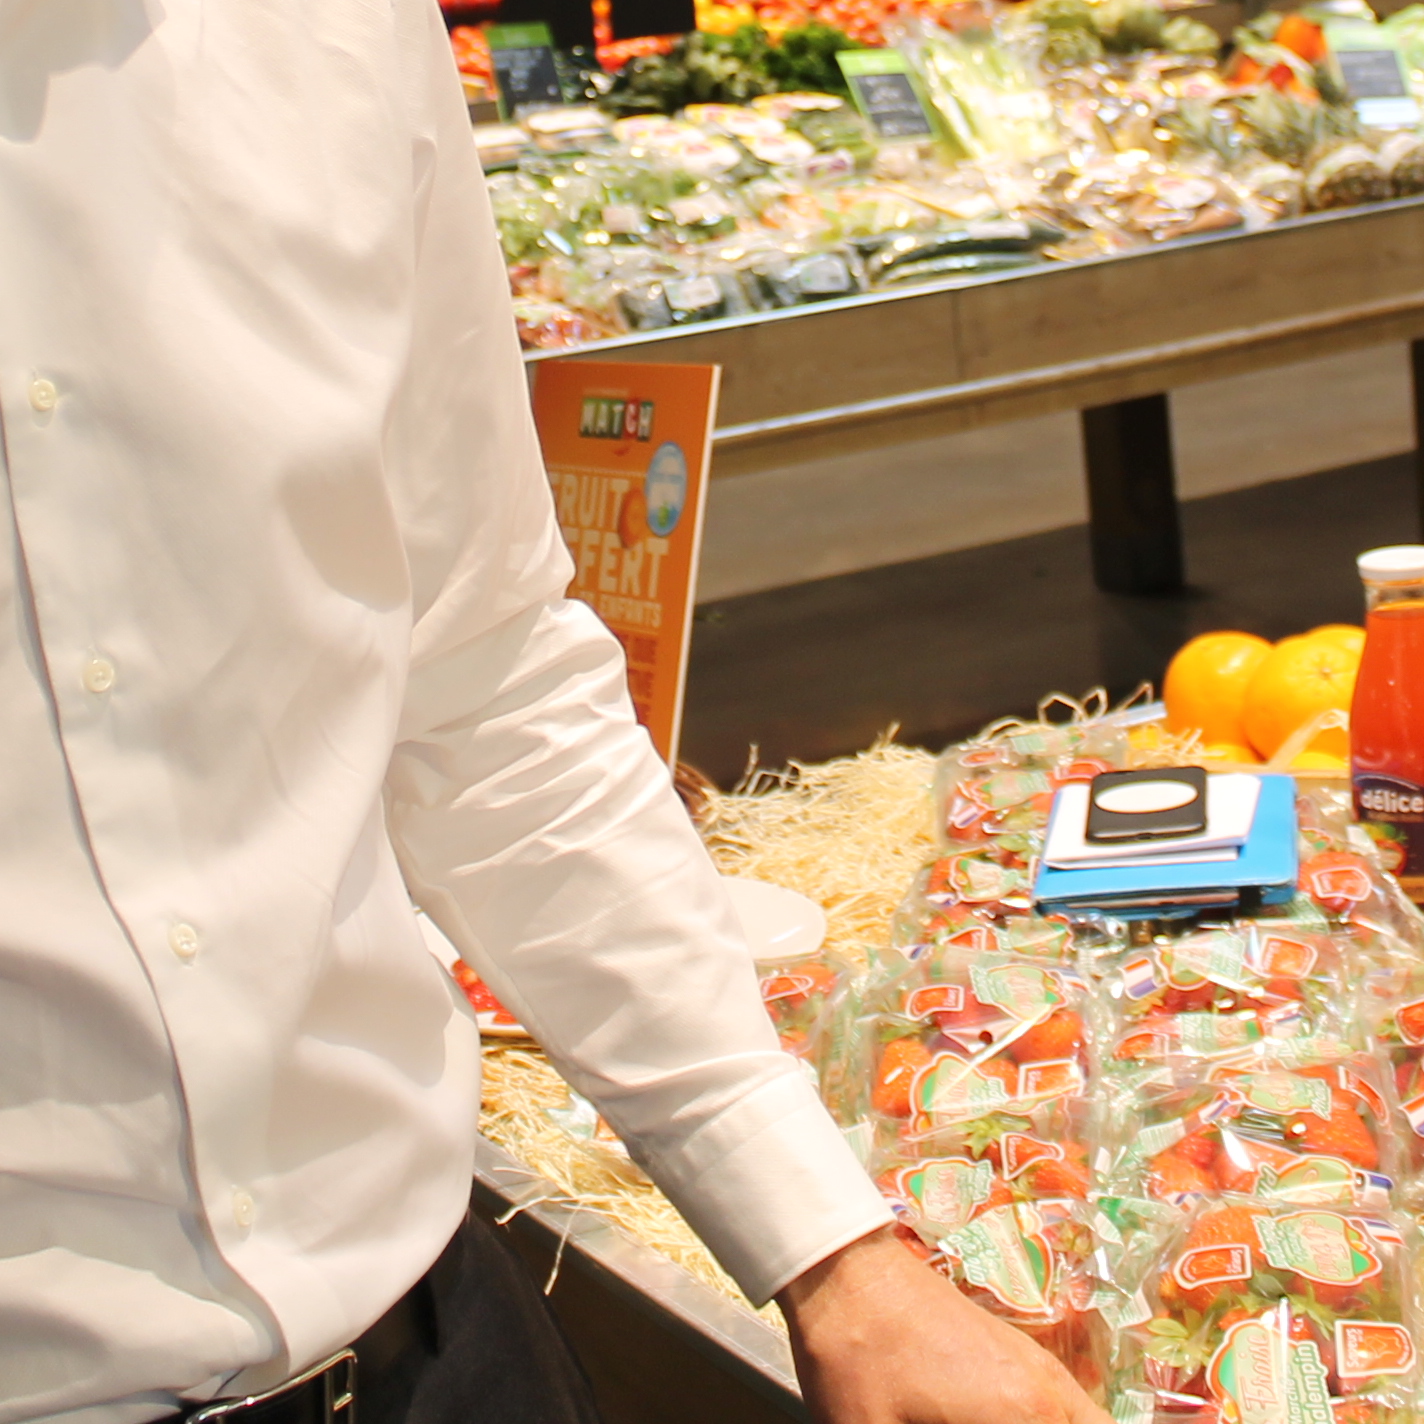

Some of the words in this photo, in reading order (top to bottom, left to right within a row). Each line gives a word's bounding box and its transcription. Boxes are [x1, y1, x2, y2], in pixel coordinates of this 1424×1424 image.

[580, 400, 654, 440] MATCH
[562, 526, 670, 600] FERT
[1301, 1343, 1325, 1423] alempin
